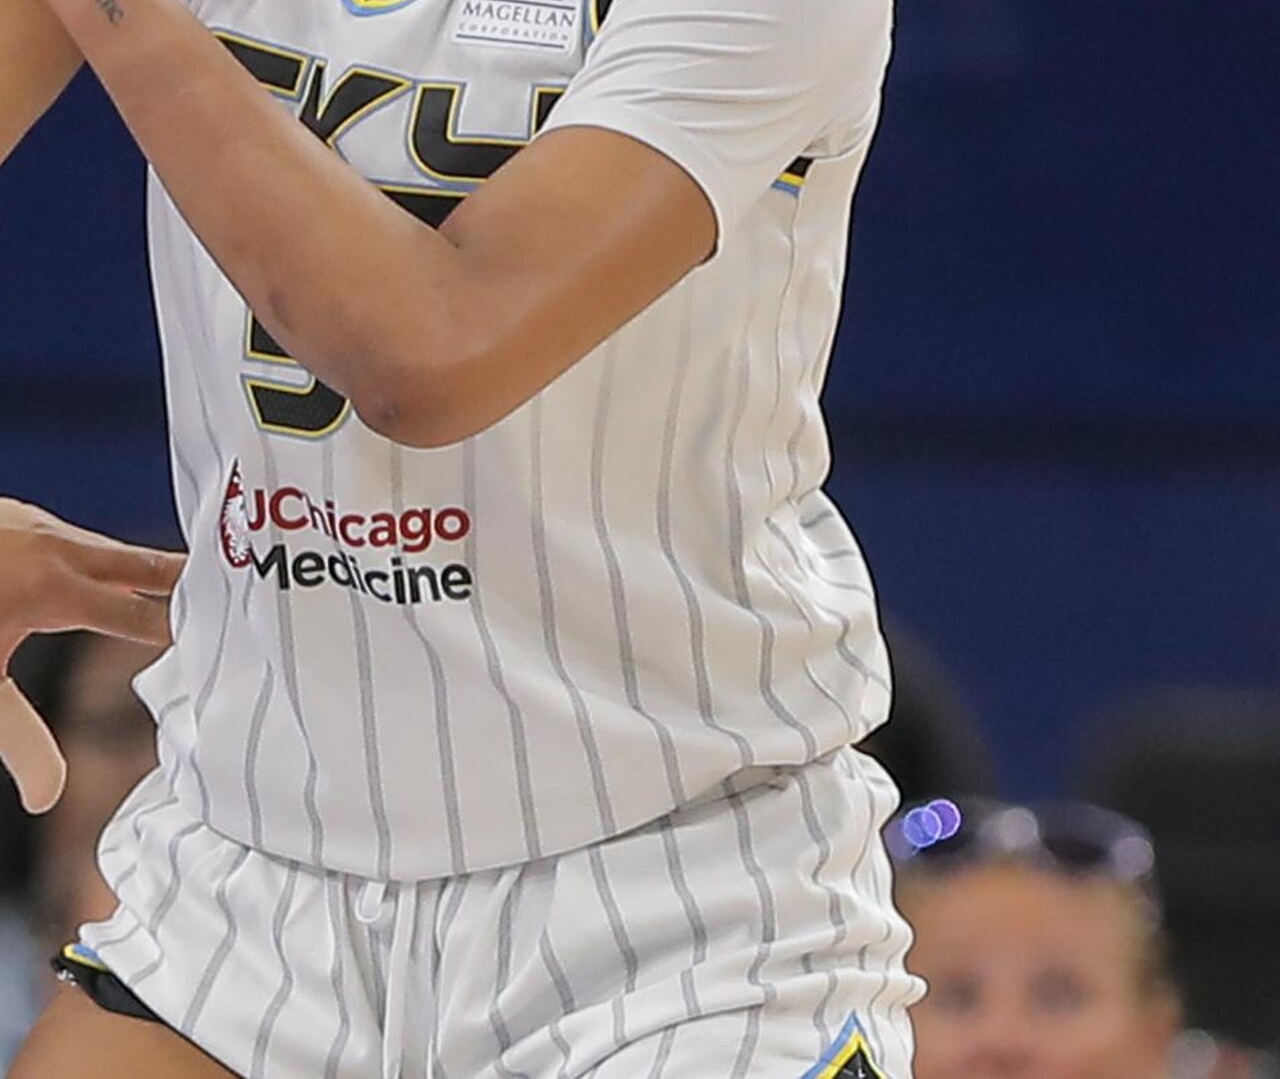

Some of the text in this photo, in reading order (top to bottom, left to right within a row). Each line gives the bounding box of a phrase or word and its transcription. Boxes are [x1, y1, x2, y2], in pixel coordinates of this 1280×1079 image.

[462, 0, 576, 28] MAGELLAN
[458, 22, 569, 41] CORPORATION
[248, 540, 473, 605] Medicine
